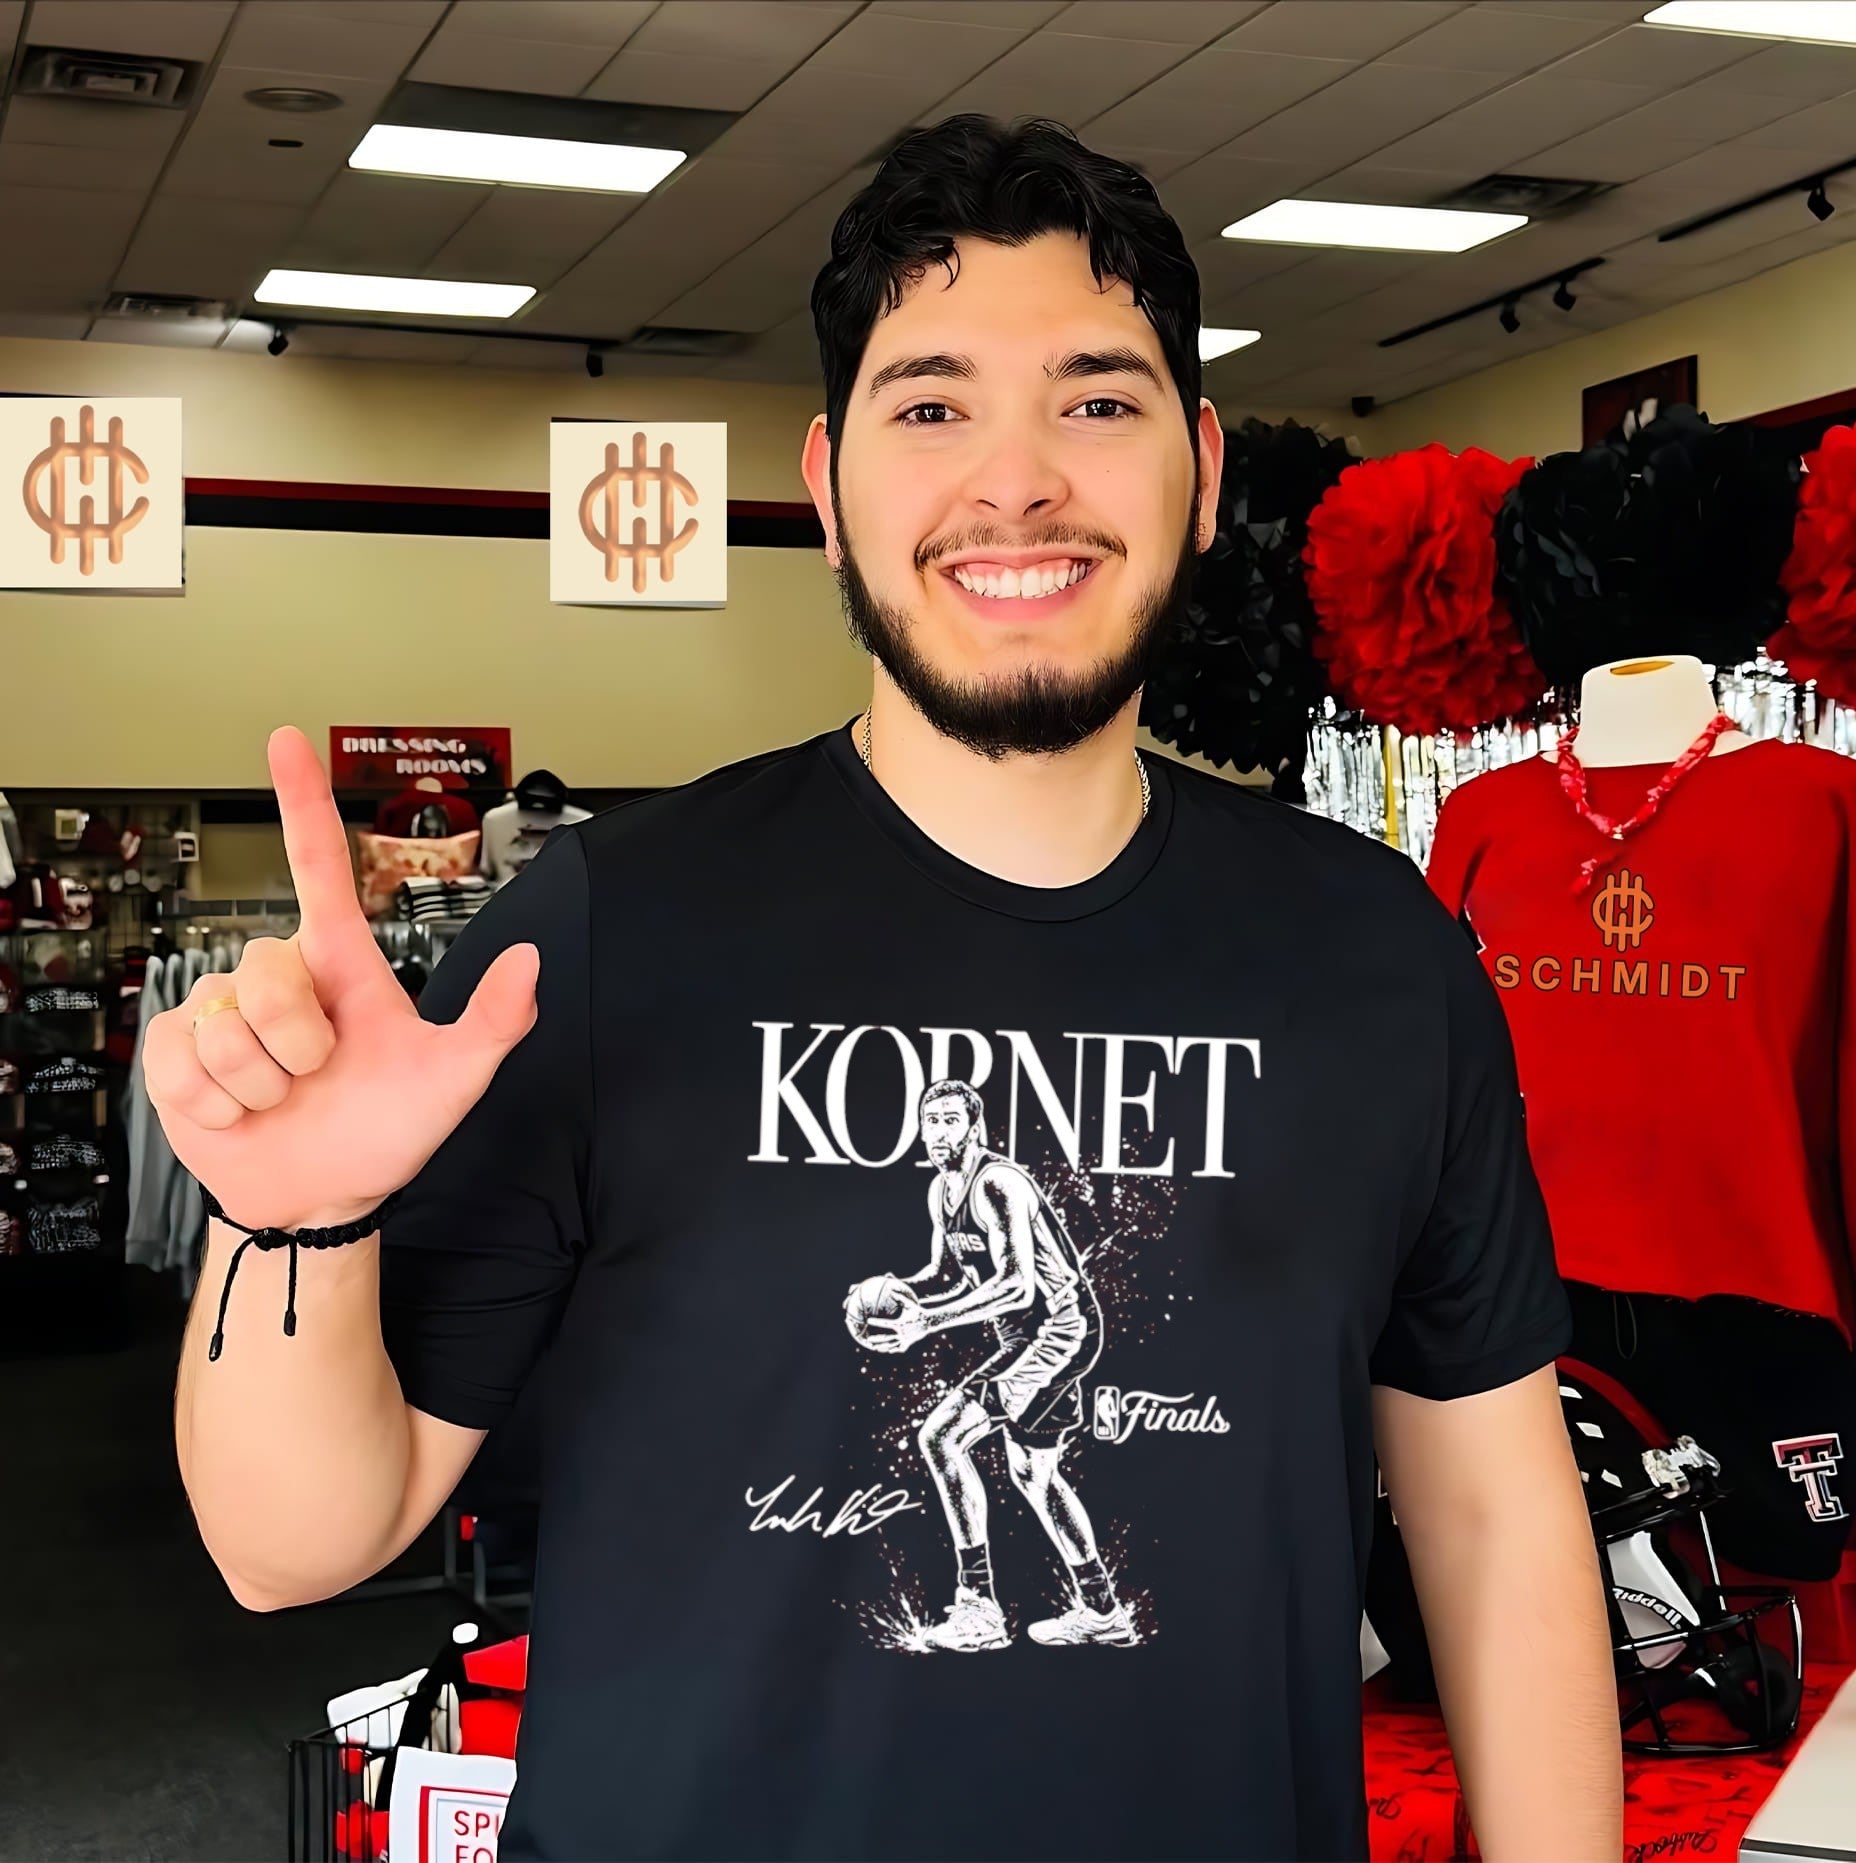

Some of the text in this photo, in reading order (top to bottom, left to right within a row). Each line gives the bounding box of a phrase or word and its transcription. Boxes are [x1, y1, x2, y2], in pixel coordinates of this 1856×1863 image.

[396, 758, 487, 775] ROOMS
[1494, 954, 1747, 1000] SCHMIDT
[1113, 1390, 1231, 1444] Finals
